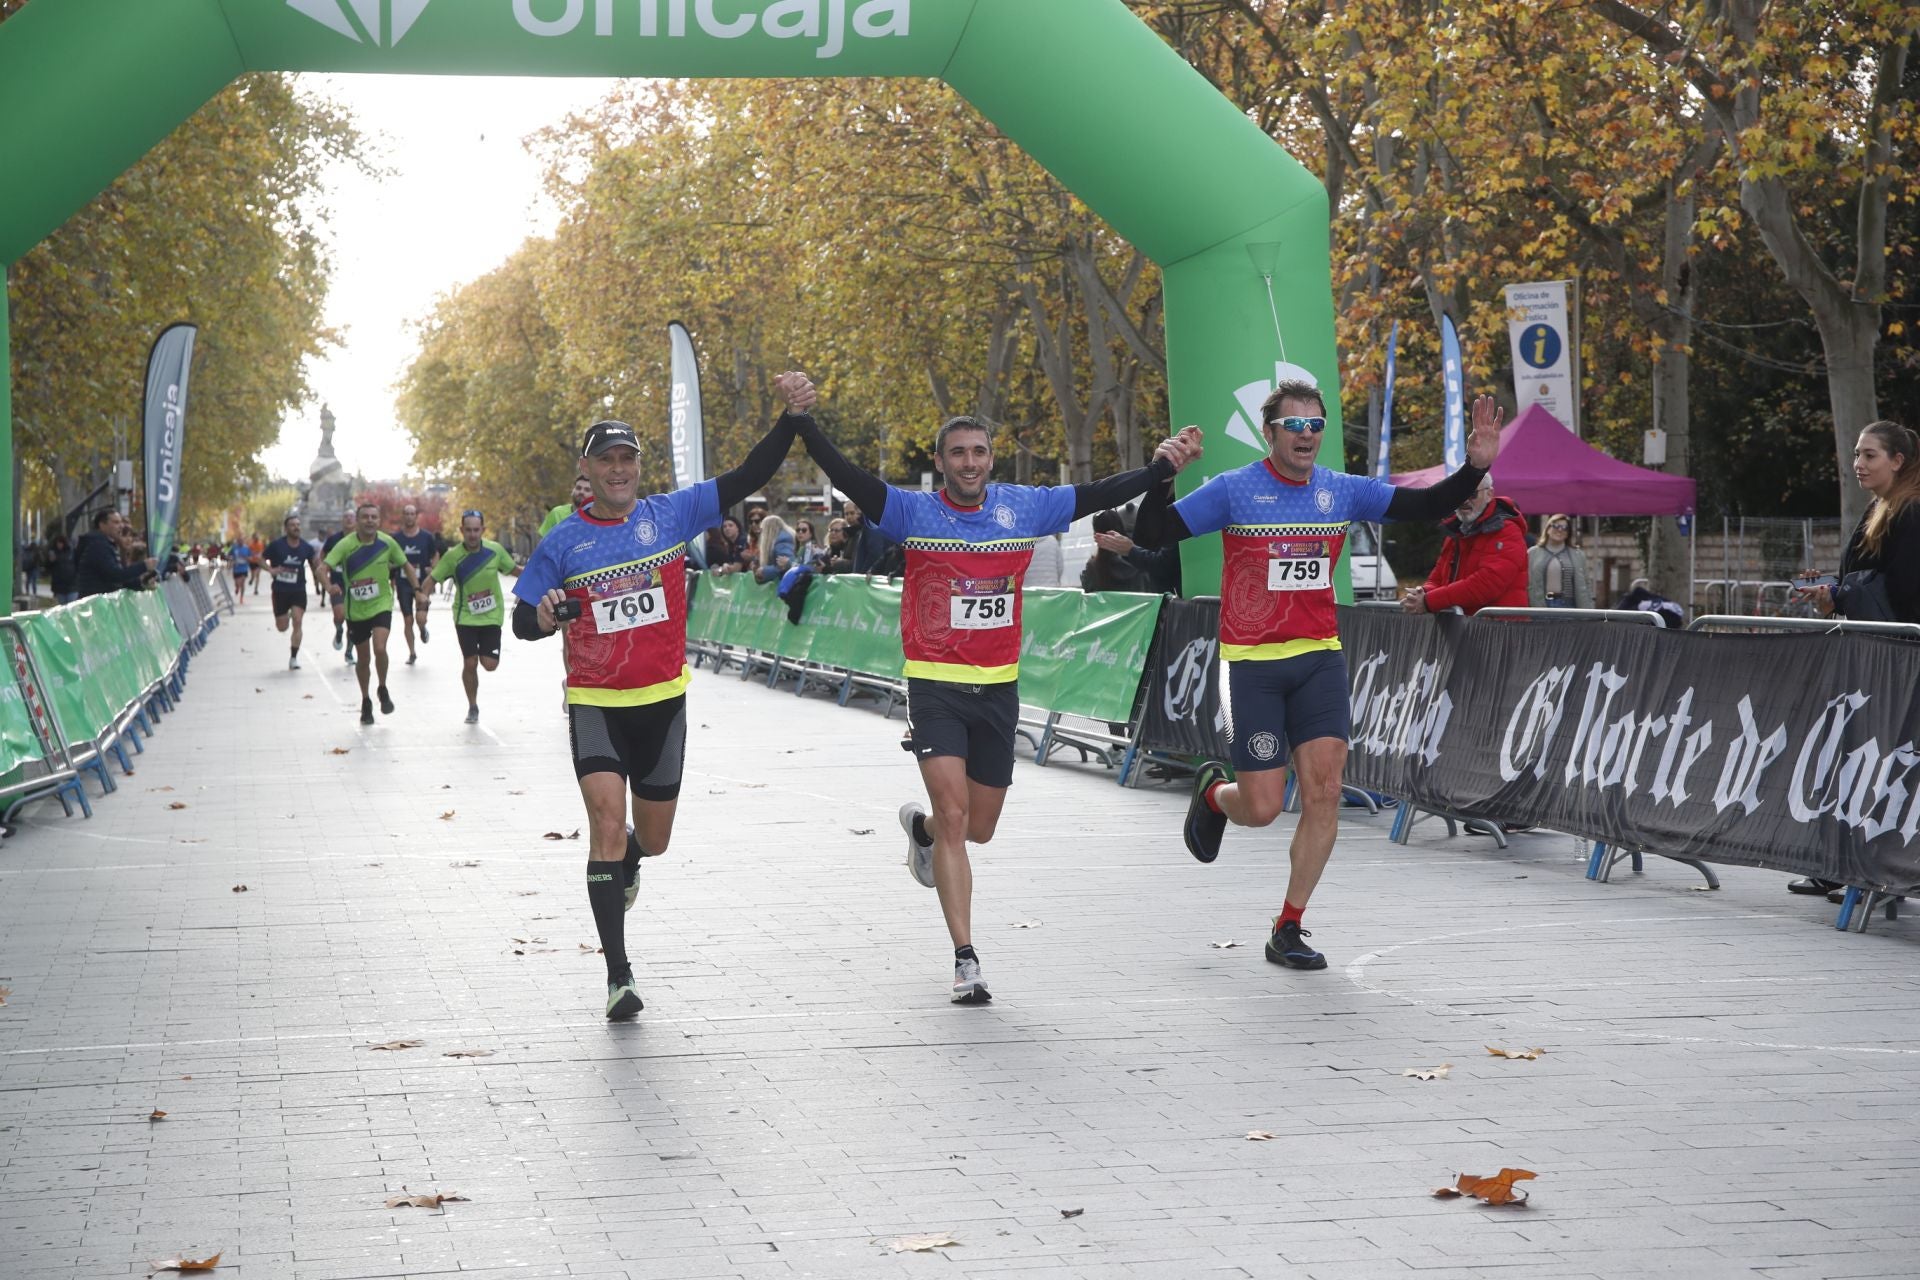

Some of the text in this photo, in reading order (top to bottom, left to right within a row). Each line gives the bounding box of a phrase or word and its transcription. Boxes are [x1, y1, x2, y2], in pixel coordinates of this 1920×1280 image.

[1513, 292, 1539, 300] Oficina
[158, 384, 181, 501] Unicaja
[1279, 560, 1320, 580] 759
[354, 585, 374, 596] 921
[472, 598, 492, 610] 920
[602, 592, 655, 621] 760
[961, 597, 1006, 619] 758
[1500, 663, 1576, 782] El
[1565, 661, 1713, 809] Norte
[1712, 694, 1787, 816] de
